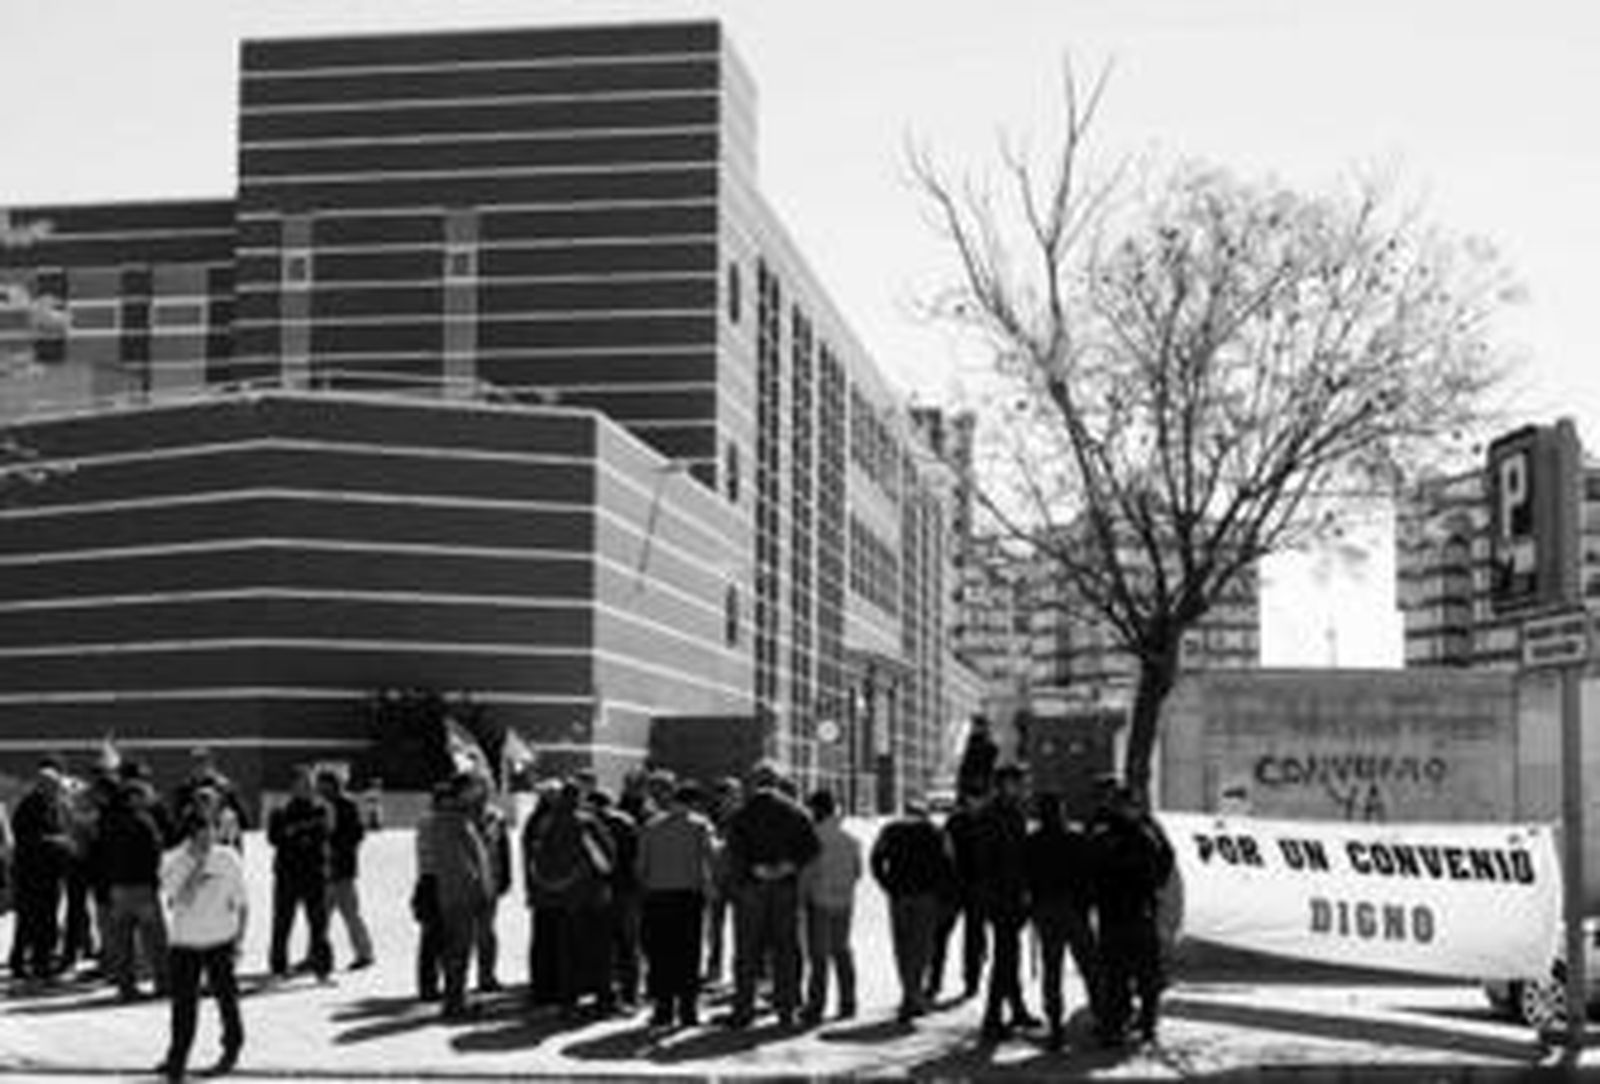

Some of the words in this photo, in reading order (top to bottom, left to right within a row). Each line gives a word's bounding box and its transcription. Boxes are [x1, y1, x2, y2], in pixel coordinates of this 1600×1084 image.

[1502, 452, 1528, 540] P
[1193, 833, 1265, 869] POR
[1277, 838, 1330, 873] UN
[1345, 840, 1537, 886] CONVENIO
[1309, 897, 1437, 945] DIGNO
